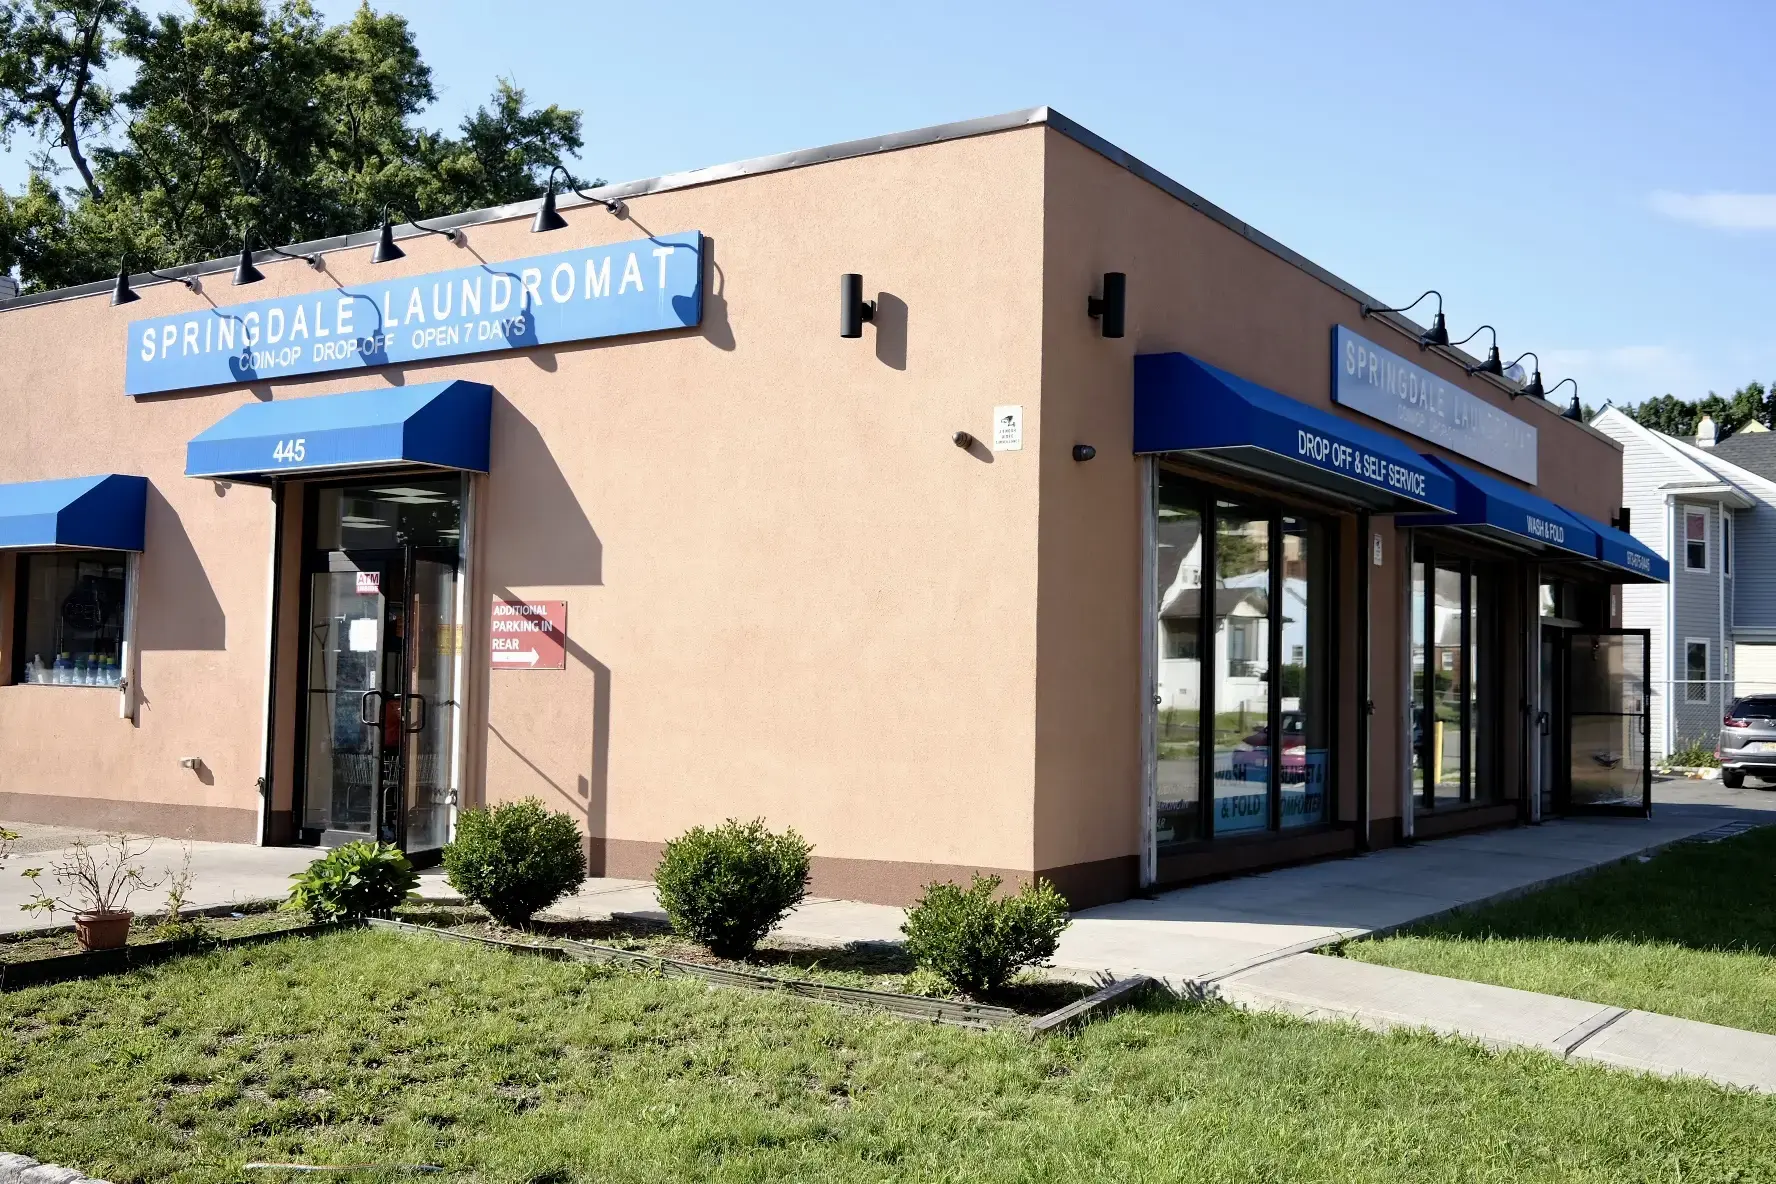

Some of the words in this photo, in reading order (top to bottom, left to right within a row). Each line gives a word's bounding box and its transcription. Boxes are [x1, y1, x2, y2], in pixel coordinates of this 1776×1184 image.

[141, 297, 354, 361] SPRINGDALE
[383, 246, 675, 328] LAUNDROMAT
[239, 346, 302, 370] COIN-OP
[313, 333, 394, 362] DROP-OFF
[411, 324, 459, 350] OPEN
[464, 323, 472, 340] 7
[477, 316, 526, 340] DAYS
[1346, 340, 1445, 417] SPRINGDALE
[272, 438, 306, 463] 445
[1298, 430, 1330, 462] DROP
[1332, 443, 1352, 469] OFF
[1354, 451, 1362, 475] &
[1363, 454, 1386, 481] SELF
[1388, 463, 1425, 496] SERVICE
[1526, 514, 1544, 537] WASH
[1545, 521, 1549, 539] &
[1550, 523, 1564, 543] FOLD
[357, 573, 379, 584] ATM
[493, 605, 548, 616] ADDITIONAL
[492, 620, 539, 632] PARKING
[541, 620, 553, 631] IN
[492, 638, 520, 650] REAR
[1221, 797, 1229, 819] &
[1232, 794, 1261, 817] FOLD
